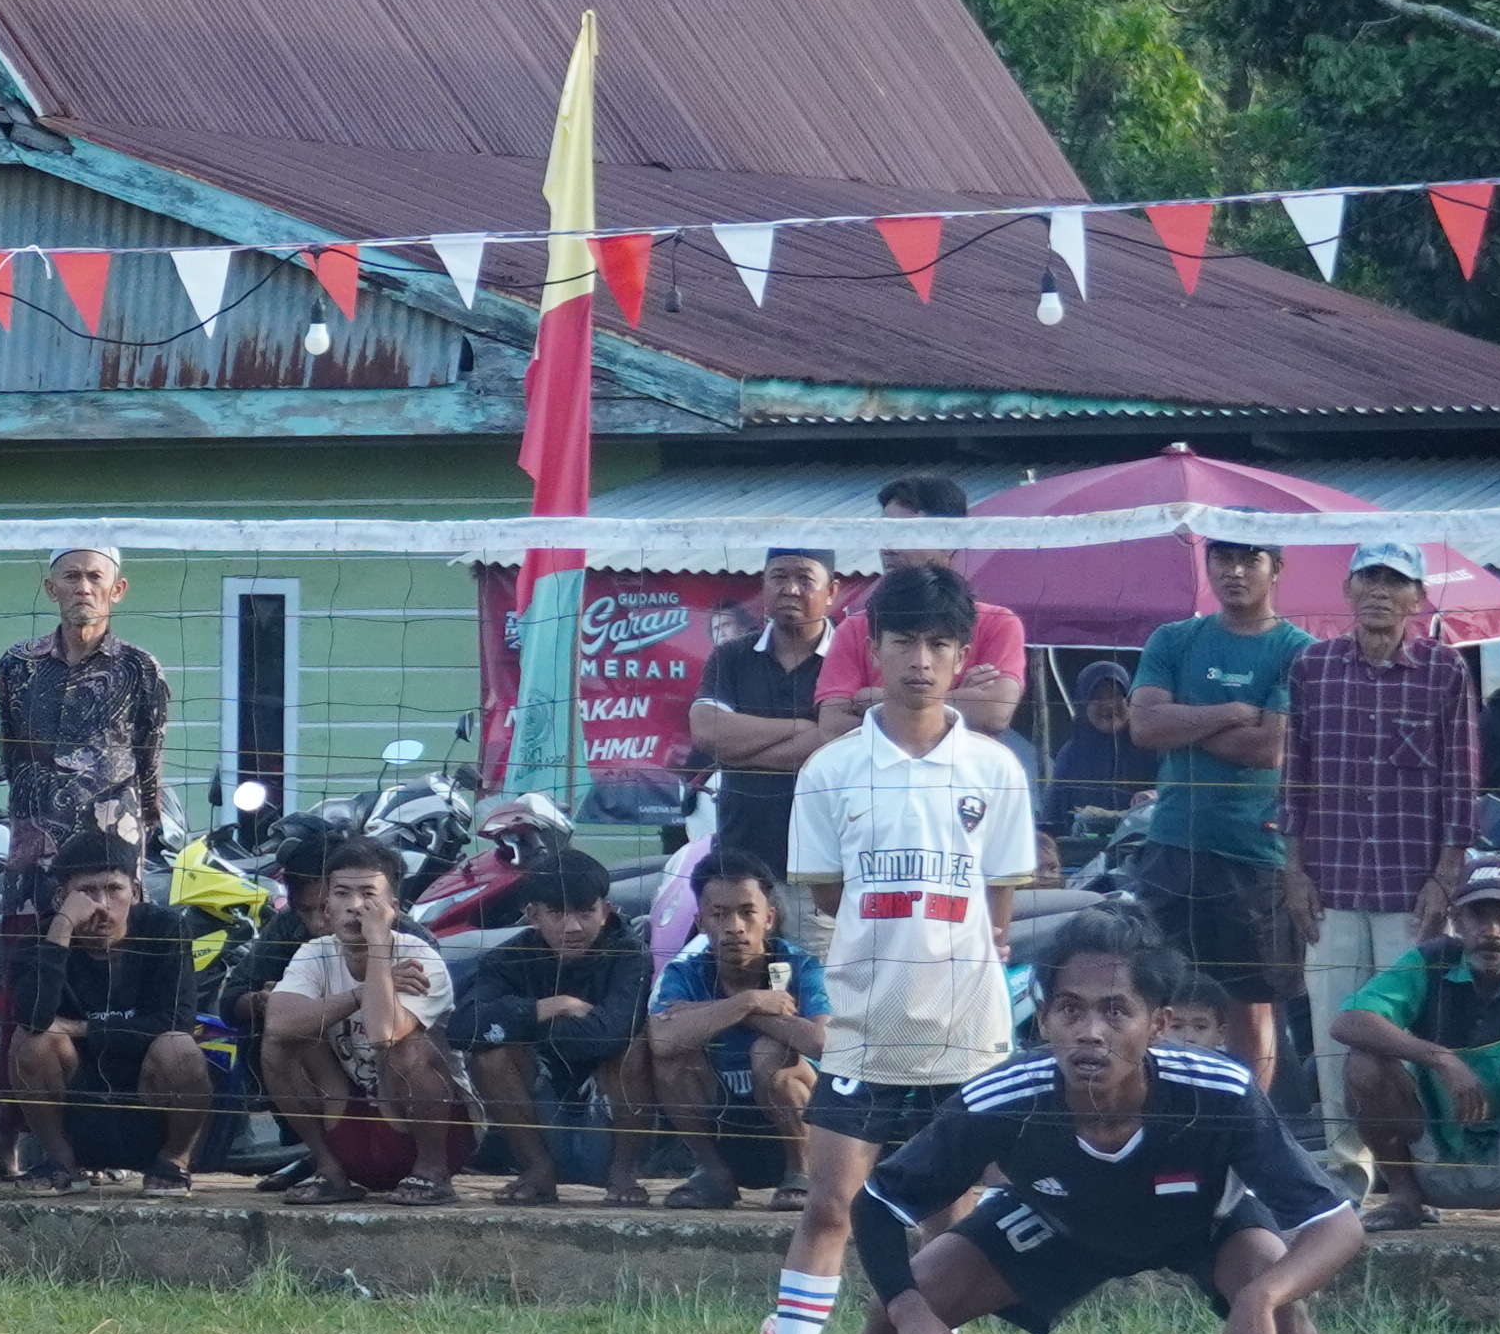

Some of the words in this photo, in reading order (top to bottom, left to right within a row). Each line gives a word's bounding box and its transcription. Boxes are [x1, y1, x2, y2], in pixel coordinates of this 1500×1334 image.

[618, 593, 679, 605] GUDANG
[580, 596, 690, 655] Garam
[580, 660, 686, 678] MERAH
[996, 1203, 1055, 1253] 10
